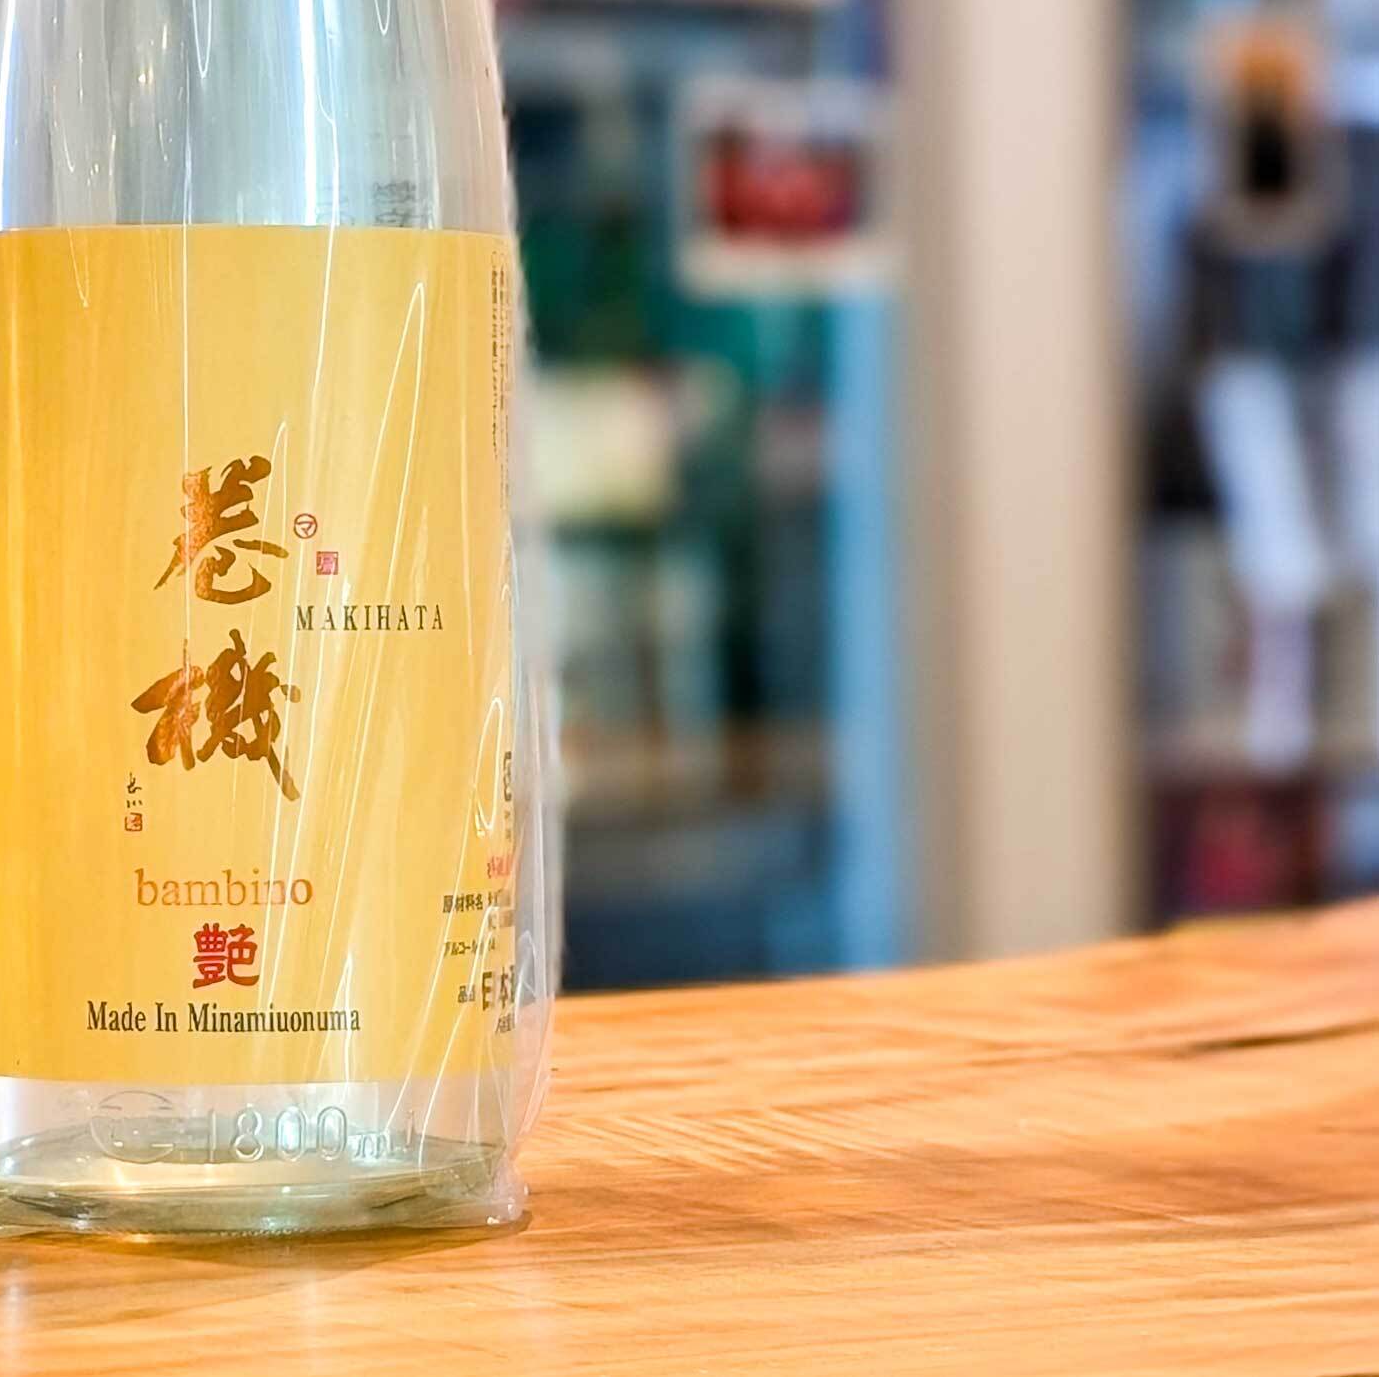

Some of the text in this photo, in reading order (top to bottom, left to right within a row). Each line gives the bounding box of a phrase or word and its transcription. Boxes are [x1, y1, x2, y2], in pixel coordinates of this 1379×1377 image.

[296, 603, 444, 631] MAKIHATA
[134, 867, 313, 907] bambino
[87, 1000, 361, 1033] Made In Minamiuonuma
